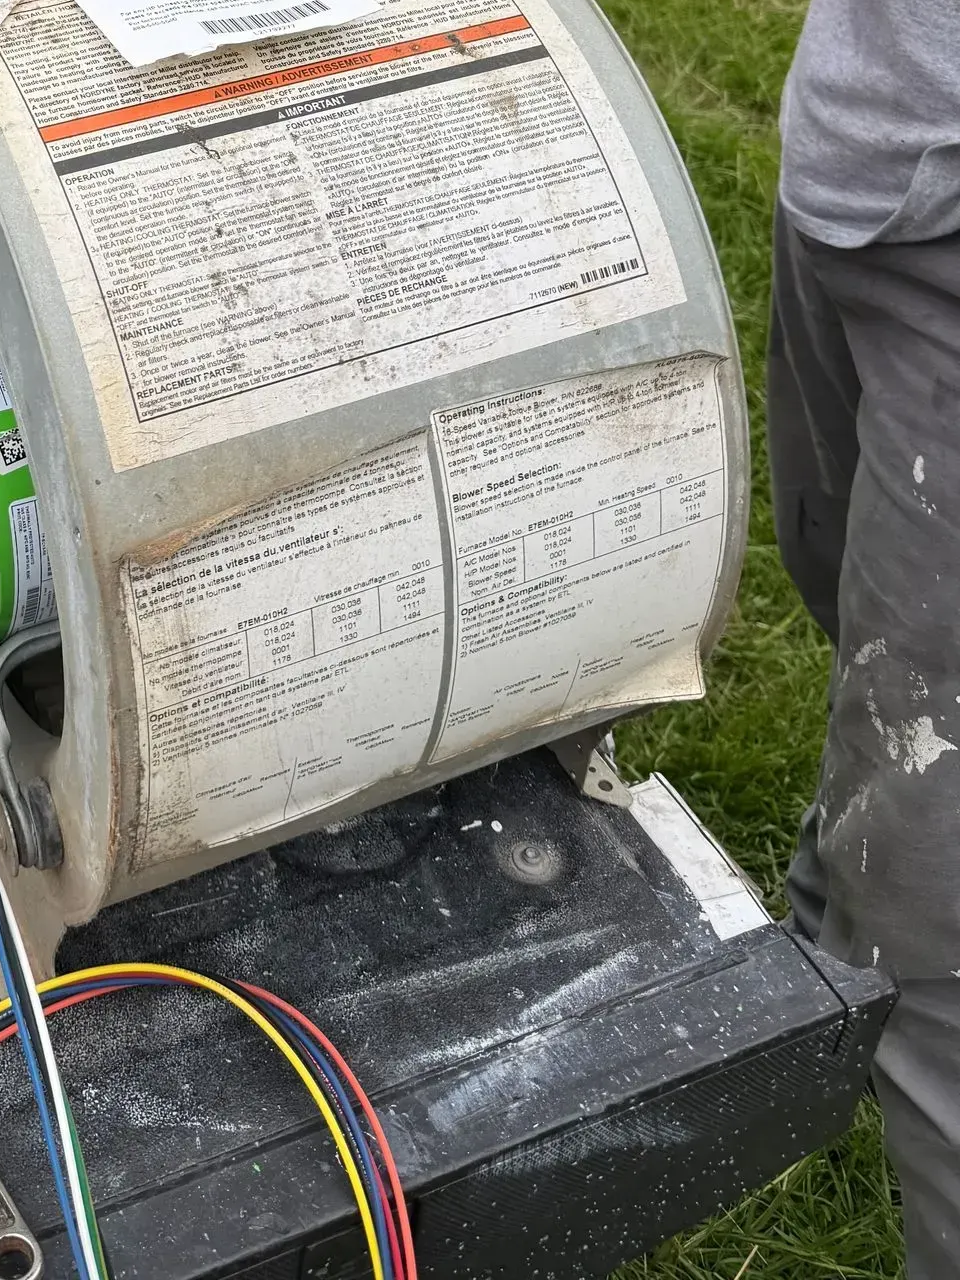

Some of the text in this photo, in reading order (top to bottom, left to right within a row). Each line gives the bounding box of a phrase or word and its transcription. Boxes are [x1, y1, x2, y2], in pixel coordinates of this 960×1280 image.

[27, 94, 51, 103] Please
[52, 87, 79, 98] contact
[78, 84, 95, 93] your
[95, 79, 113, 87] local
[113, 71, 150, 83] Intertherm
[157, 65, 176, 73] Miller
[177, 57, 212, 69] distributor
[220, 77, 273, 95] WARNING
[281, 53, 375, 82] ADVERTISSEMENT
[61, 139, 81, 149] avoid
[81, 135, 102, 144] injury
[121, 124, 148, 134] moving
[148, 120, 169, 128] parts,
[169, 112, 192, 123] switch
[205, 104, 228, 114] circuit
[227, 98, 253, 108] breaker
[274, 87, 295, 96] "OFF"
[284, 94, 345, 117] IMPORTANT
[285, 106, 359, 131] FONCTIONNEMENT
[64, 168, 115, 186] OPERATION
[325, 208, 346, 220] MISE
[354, 197, 388, 212] L'ARRÊT
[339, 241, 387, 260] ENTRETIEN
[105, 280, 147, 298] SHUT-OFF
[356, 274, 447, 306] PIÈCES DE RECHANGE
[557, 280, 578, 293] (NEW)
[119, 317, 184, 342] MAINTENANCE
[135, 365, 233, 399] REPLACEMENT PARTS
[438, 388, 546, 425] Operating Instructions:
[452, 462, 561, 503] Blower Speed Selection:
[527, 472, 683, 531] E7EM-010H2 0010
[549, 502, 700, 560] 0001 1101 1111
[550, 511, 700, 569] 1178 1330 1494
[150, 573, 196, 594] sélection
[198, 568, 211, 578] de
[213, 564, 223, 573] la
[278, 530, 329, 552] ventilateur
[237, 558, 431, 630] E7EM-010H2 0010
[460, 574, 567, 616] Options & Compatibility:
[271, 599, 420, 656] 0001 1101 1111
[272, 609, 421, 666] 1178 1330 1494
[149, 675, 269, 722] Options et compatibilité:
